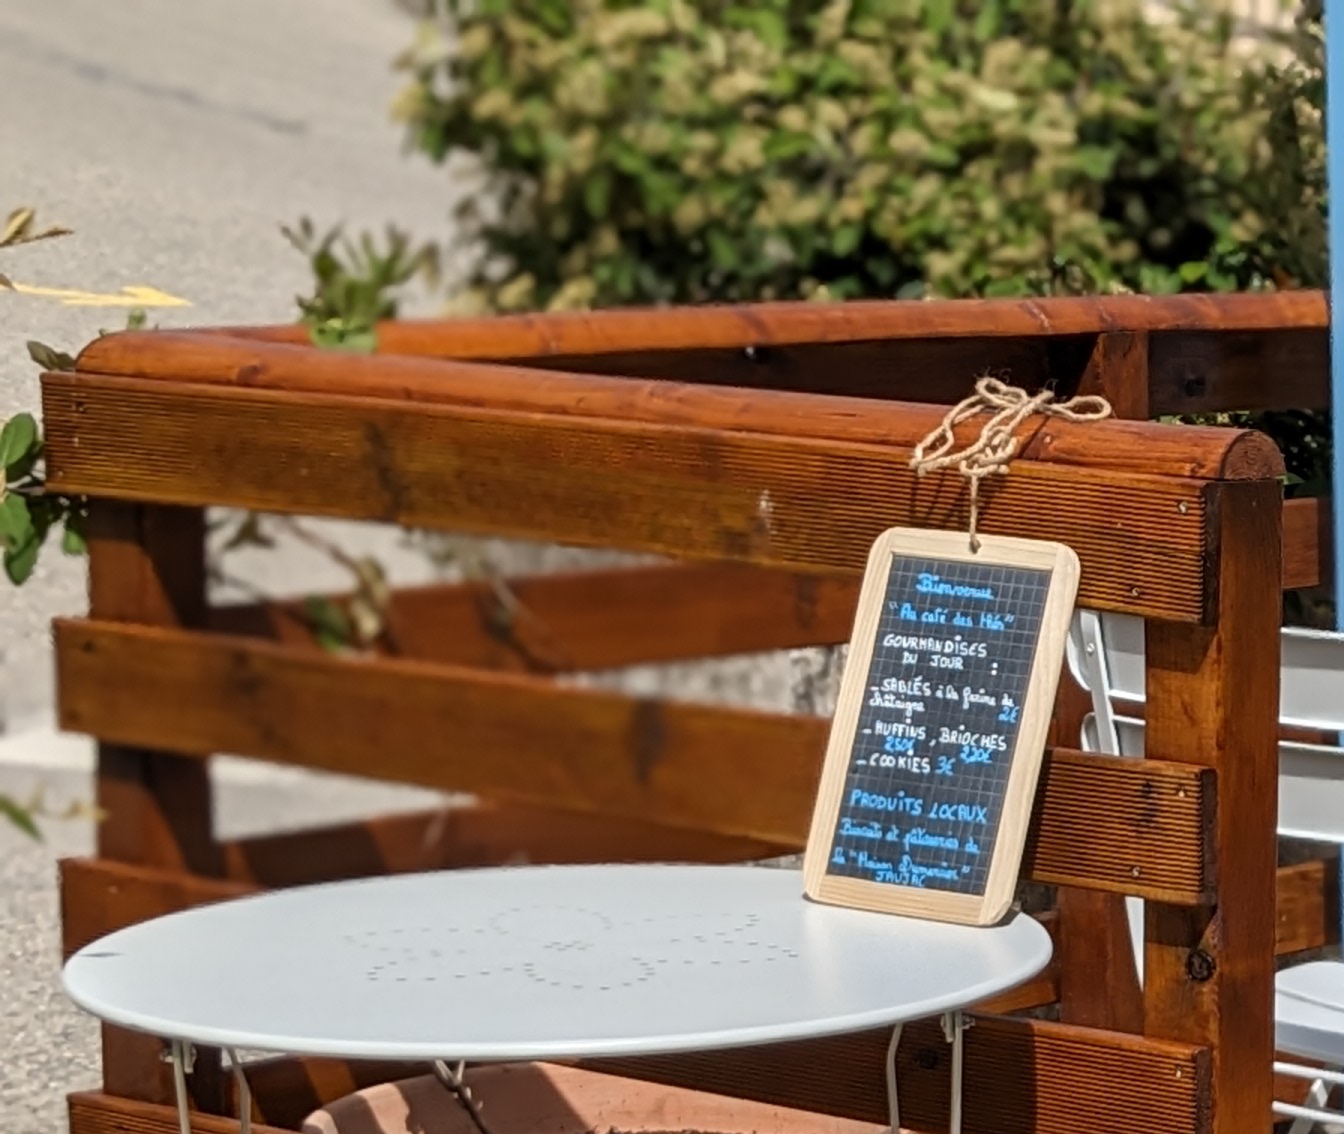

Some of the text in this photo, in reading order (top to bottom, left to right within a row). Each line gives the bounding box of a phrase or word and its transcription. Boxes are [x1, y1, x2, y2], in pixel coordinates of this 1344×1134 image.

[916, 572, 996, 600] Bienvenue
[921, 607, 949, 625] café
[953, 612, 973, 628] des
[902, 651, 918, 665] DU
[930, 654, 964, 670] JOUR
[880, 675, 932, 697] SABLÉS
[875, 717, 927, 740] MUFFINS
[938, 724, 1007, 751] BRIOCHES
[869, 748, 931, 775] COOKIES
[851, 789, 988, 825] PRODUITS LOCAUX
